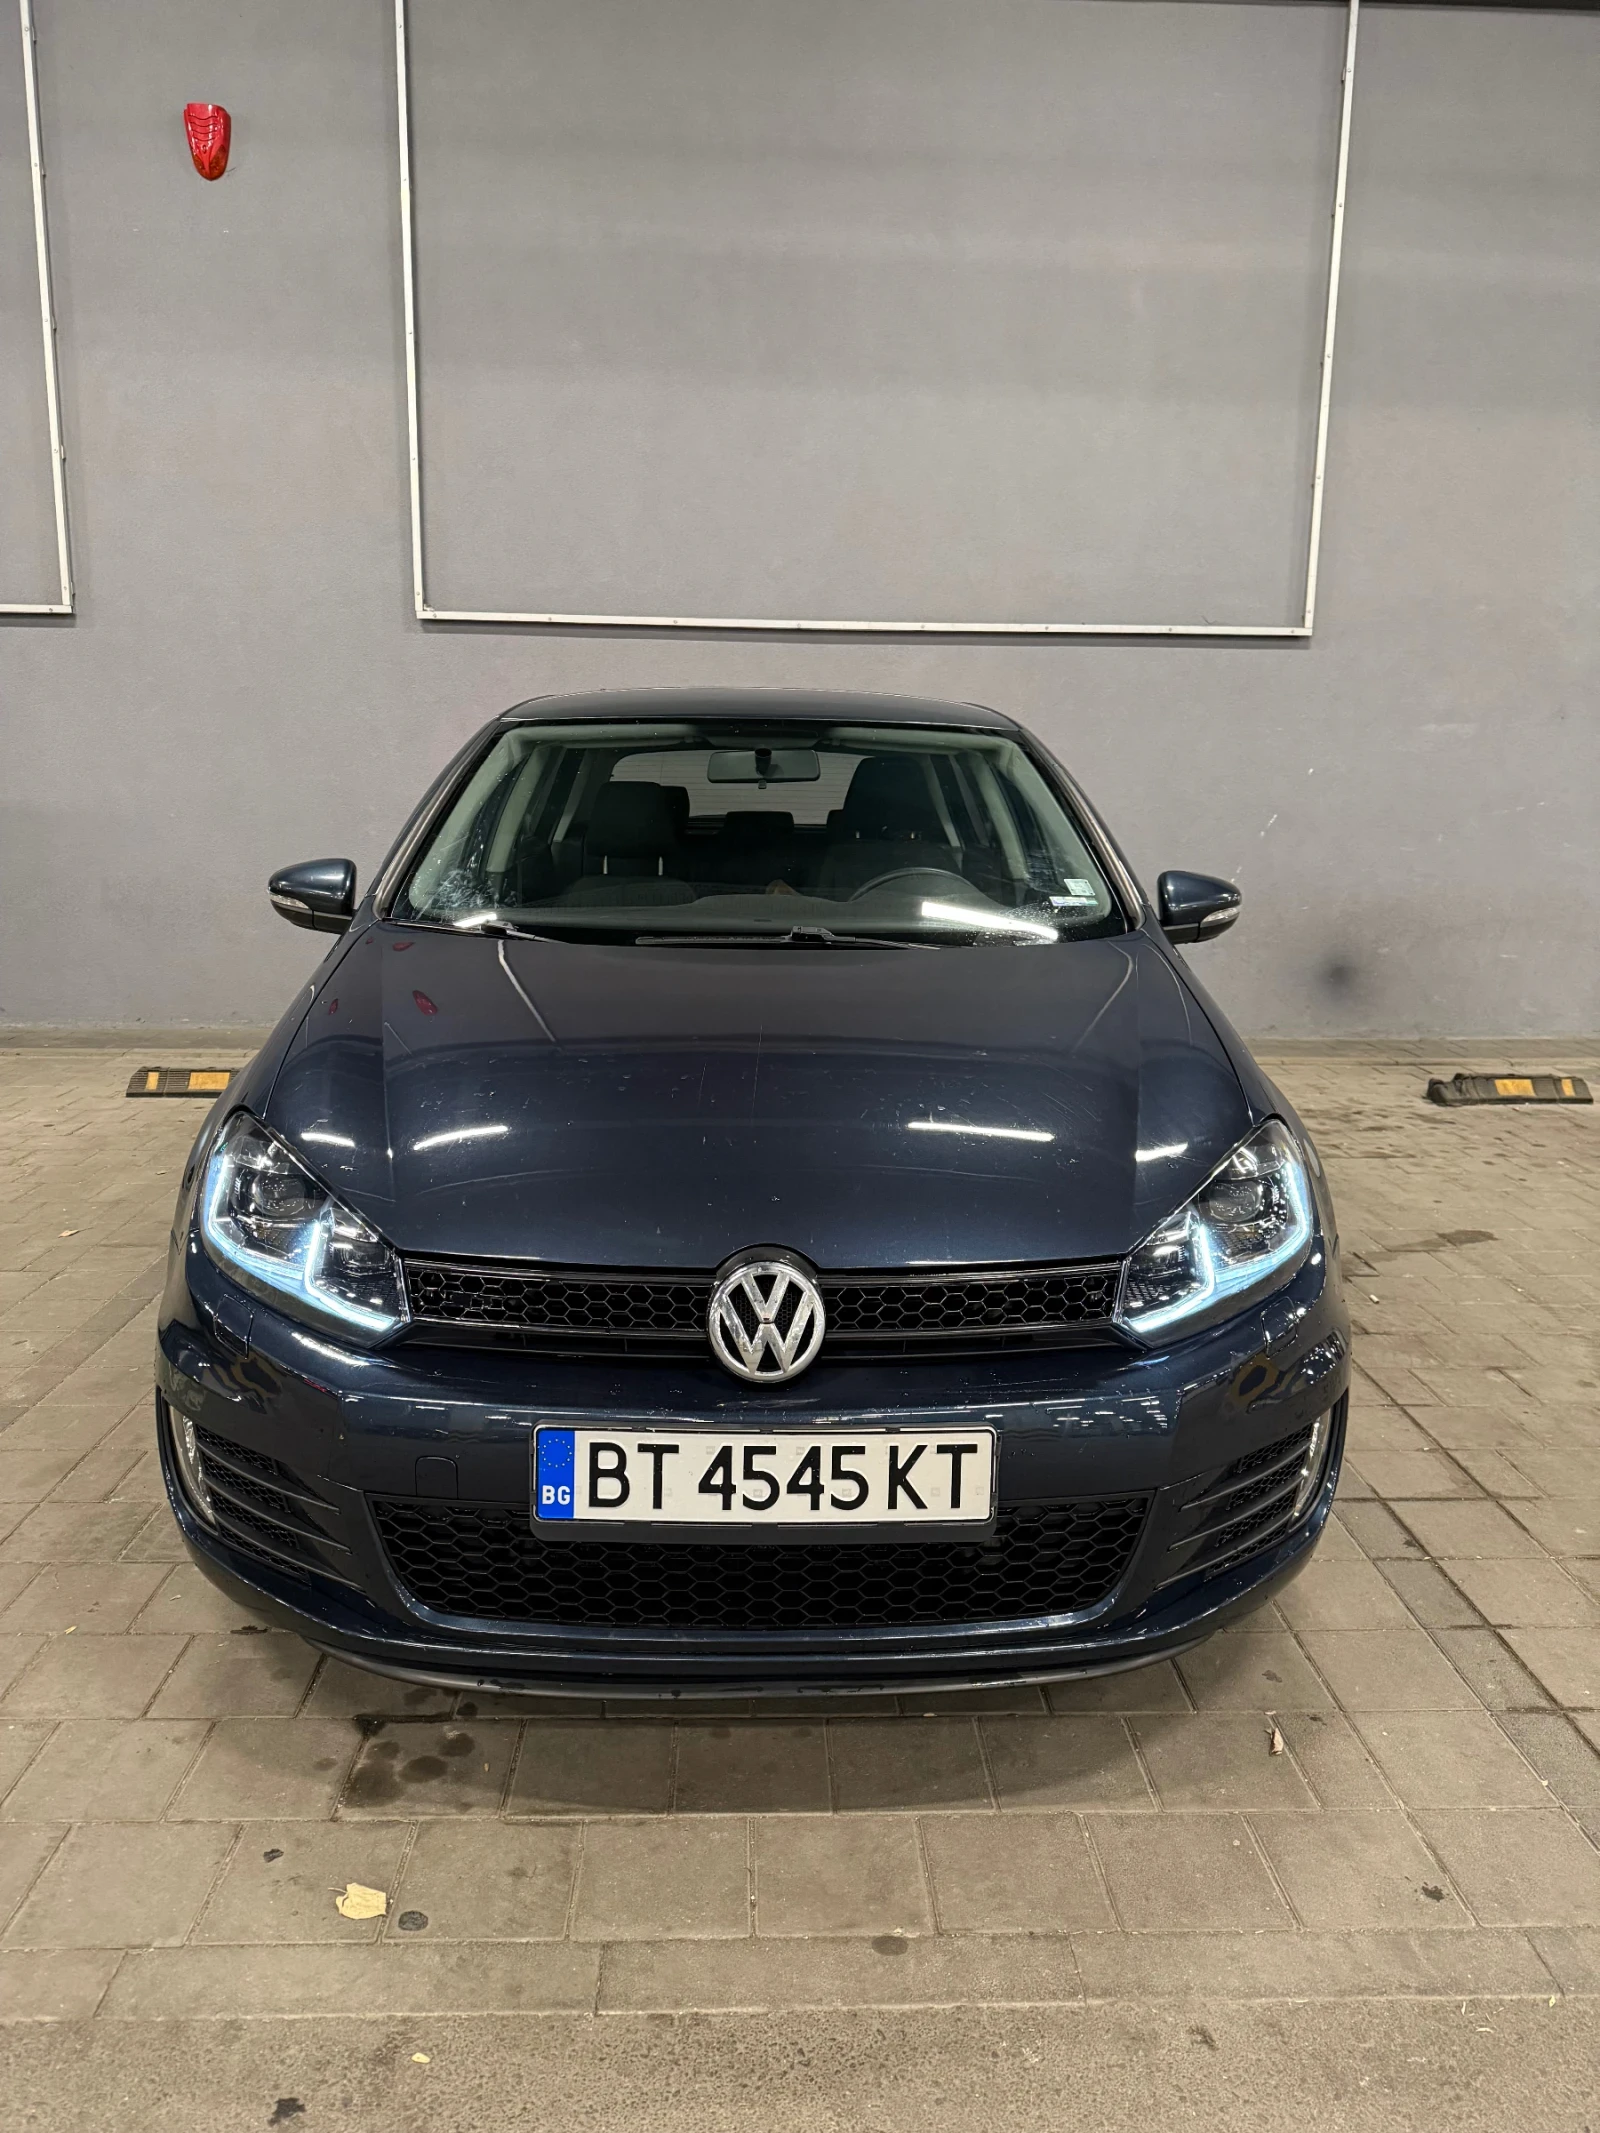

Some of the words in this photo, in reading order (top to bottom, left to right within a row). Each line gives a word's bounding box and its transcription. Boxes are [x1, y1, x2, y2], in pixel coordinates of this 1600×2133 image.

[712, 1264, 823, 1380] VW
[542, 1485, 571, 1505] BG
[588, 1441, 679, 1509] BT
[698, 1445, 869, 1511] 4545
[887, 1444, 978, 1510] KT
